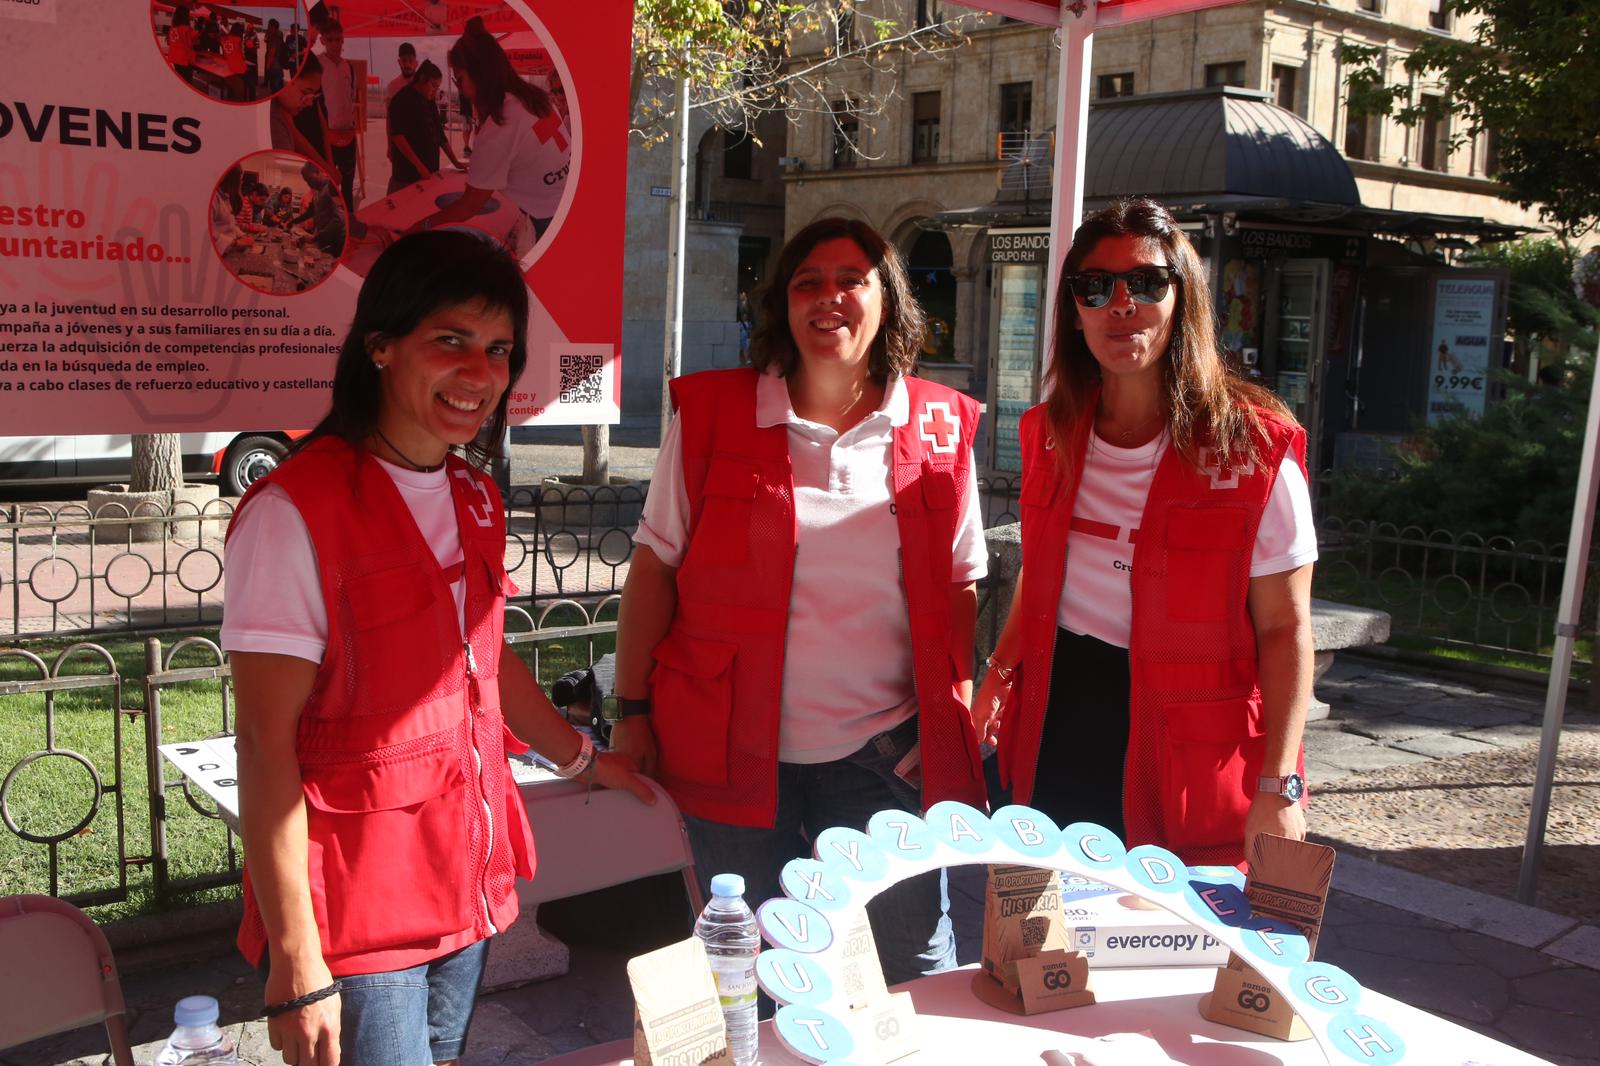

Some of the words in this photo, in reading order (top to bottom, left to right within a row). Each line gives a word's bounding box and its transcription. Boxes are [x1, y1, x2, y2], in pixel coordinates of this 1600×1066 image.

[0, 205, 85, 228] estro
[0, 235, 191, 263] untariado...
[992, 236, 1011, 249] LOS
[992, 251, 1020, 261] GRUPO
[0, 303, 17, 316] ya
[21, 304, 30, 313] a
[34, 302, 47, 314] la
[50, 302, 116, 316] juventud
[120, 306, 137, 315] en
[141, 306, 156, 315] su
[161, 305, 228, 317] desarrollo
[232, 307, 290, 320] personal.
[0, 321, 50, 336] mpaña
[54, 324, 62, 333] a
[66, 321, 122, 336] jóvenes
[125, 325, 134, 337] y
[137, 325, 145, 334] a
[149, 325, 172, 334] sus
[175, 323, 240, 336] familiares
[244, 327, 260, 336] en
[264, 327, 278, 336] su
[281, 325, 300, 336] día
[303, 328, 310, 336] a
[313, 325, 336, 337] día.
[42, 341, 55, 352] la
[60, 341, 140, 355] adquisición
[144, 342, 161, 352] de
[165, 343, 256, 356] competencias
[258, 343, 342, 356] profesionales
[0, 360, 18, 372] da
[22, 362, 40, 372] en
[45, 360, 58, 372] la
[62, 360, 132, 374] búsqueda
[136, 361, 152, 372] de
[156, 361, 208, 374] empleo.
[16, 382, 24, 391] a
[30, 379, 64, 391] cabo
[68, 379, 111, 390] clases
[116, 380, 132, 390] de
[136, 379, 192, 390] refuerzo
[196, 379, 260, 390] educativo
[262, 380, 270, 392] y
[530, 392, 536, 402] y
[510, 405, 545, 416] contigo
[886, 821, 922, 850] Z
[950, 814, 983, 842] A
[1010, 818, 1044, 846] B
[830, 840, 864, 872] Y
[1078, 834, 1112, 863] C
[1005, 870, 1055, 887] OPORTUNIDAD
[1139, 856, 1176, 884] D
[794, 869, 836, 901] X
[1001, 893, 1058, 918] HISTORIA
[1200, 888, 1236, 916] E
[772, 911, 808, 943] V
[1106, 934, 1198, 951] evercopy
[1256, 926, 1284, 956] F
[771, 961, 812, 993] U
[1042, 962, 1067, 970] somos
[1044, 969, 1072, 990] GO
[1242, 981, 1271, 994] somos
[1304, 976, 1349, 1005] G
[1237, 990, 1271, 1012] GO
[793, 1017, 829, 1051] T
[875, 1016, 900, 1040] GO
[1343, 1024, 1394, 1057] H
